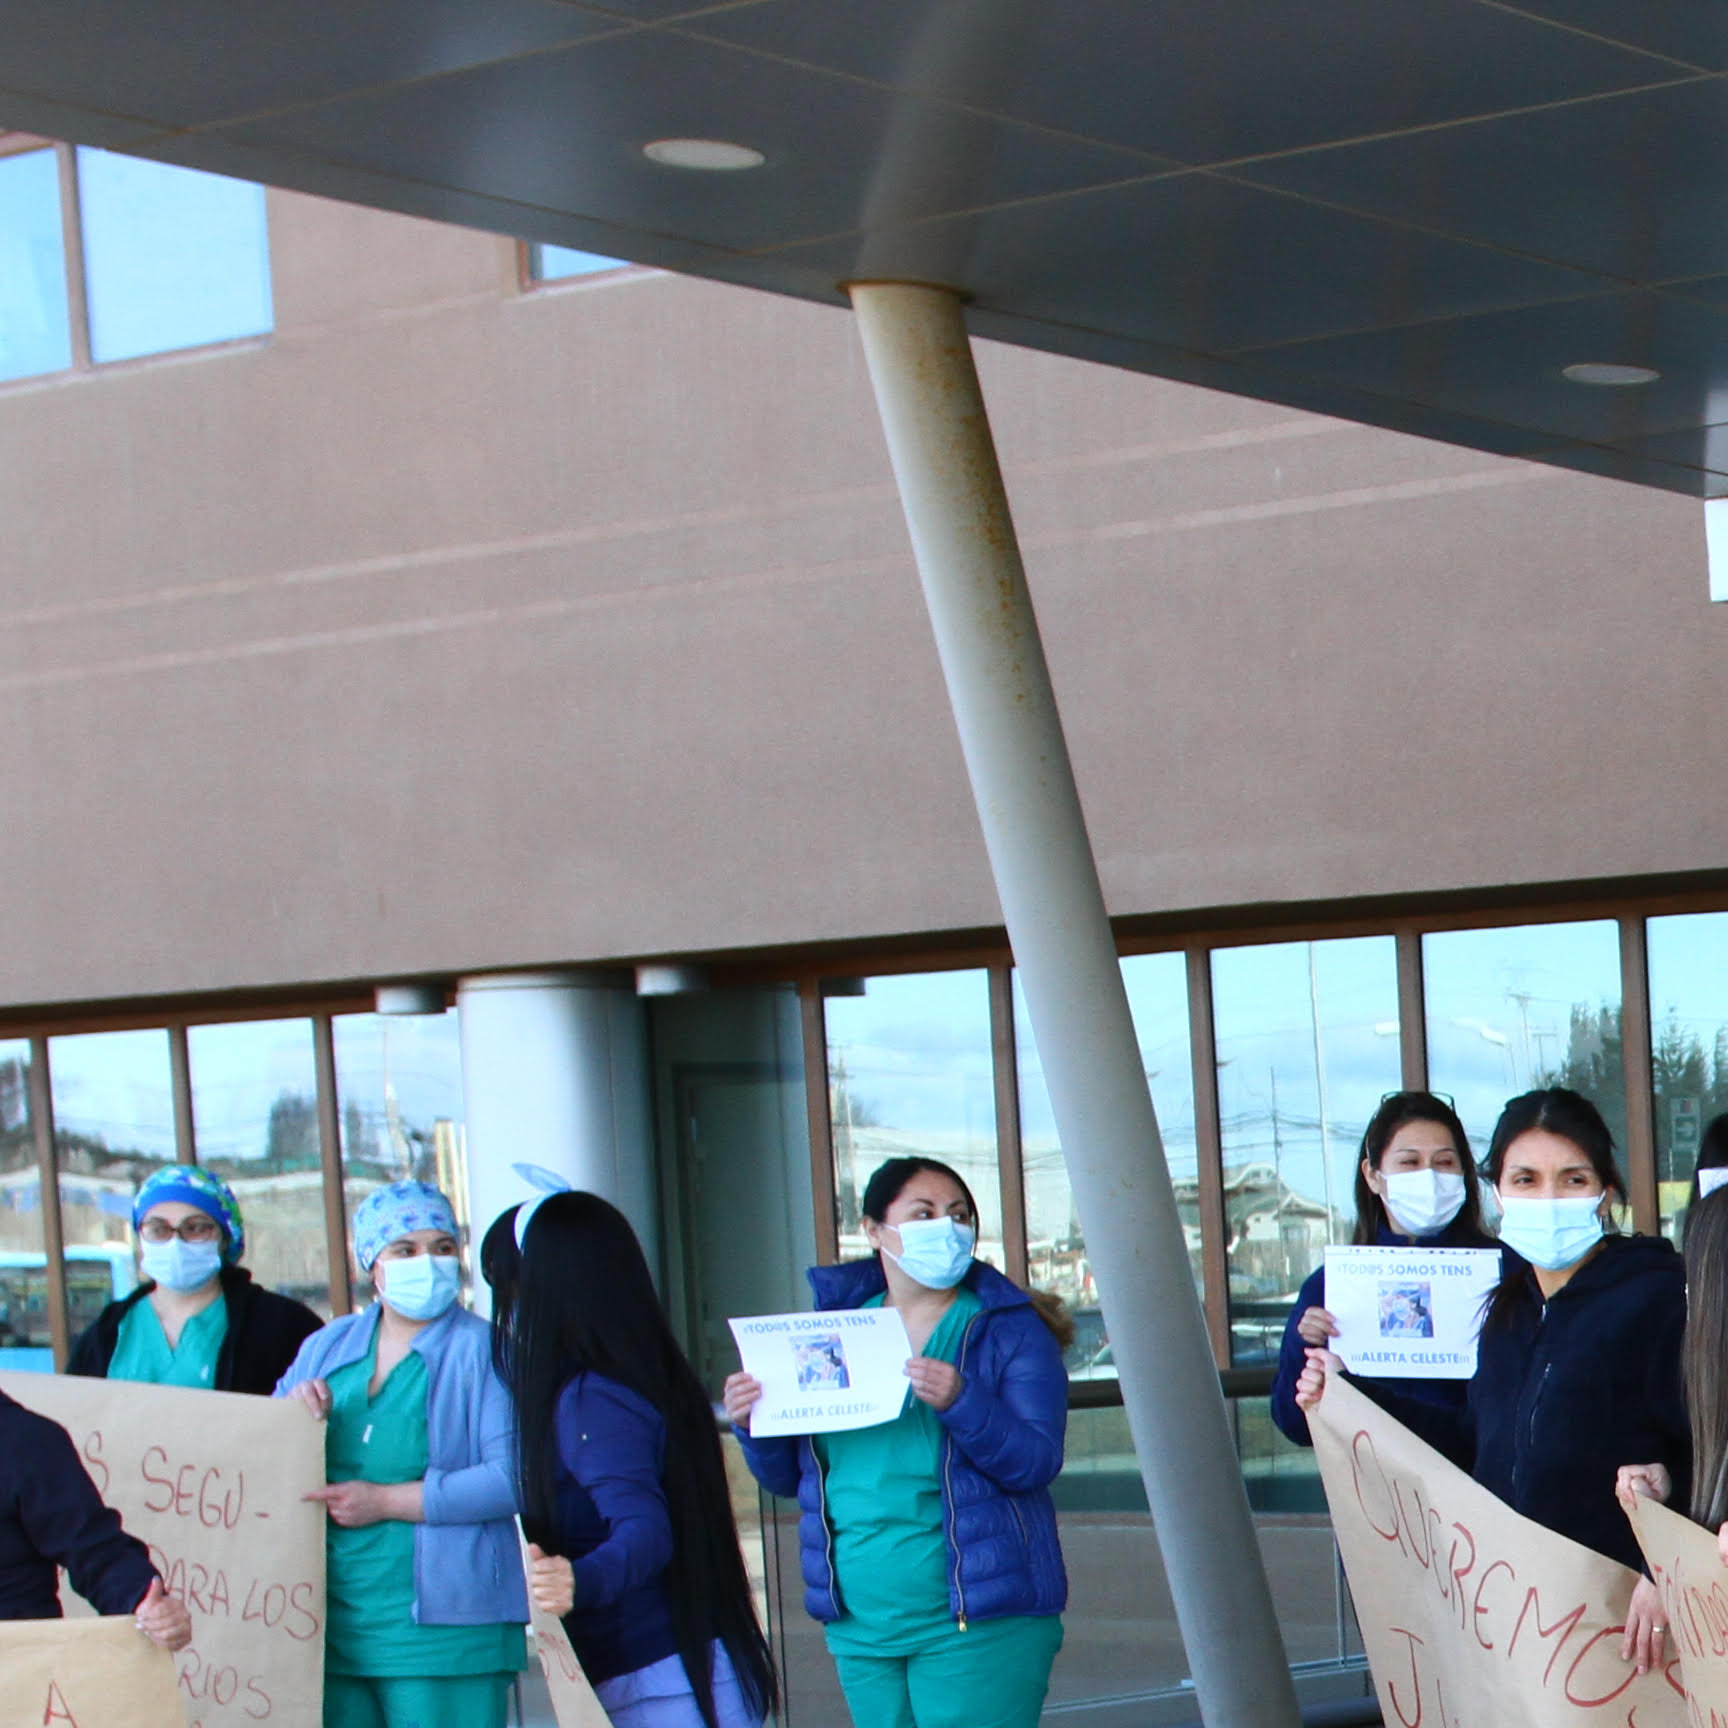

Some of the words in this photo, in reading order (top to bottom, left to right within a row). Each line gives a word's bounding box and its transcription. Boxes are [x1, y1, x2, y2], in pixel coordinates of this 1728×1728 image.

[1388, 1264, 1437, 1276] SOMOS
[1441, 1265, 1473, 1277] TENS
[794, 1317, 842, 1331] SOMOS
[844, 1315, 876, 1328] TENS
[241, 1572, 320, 1641] LOS
